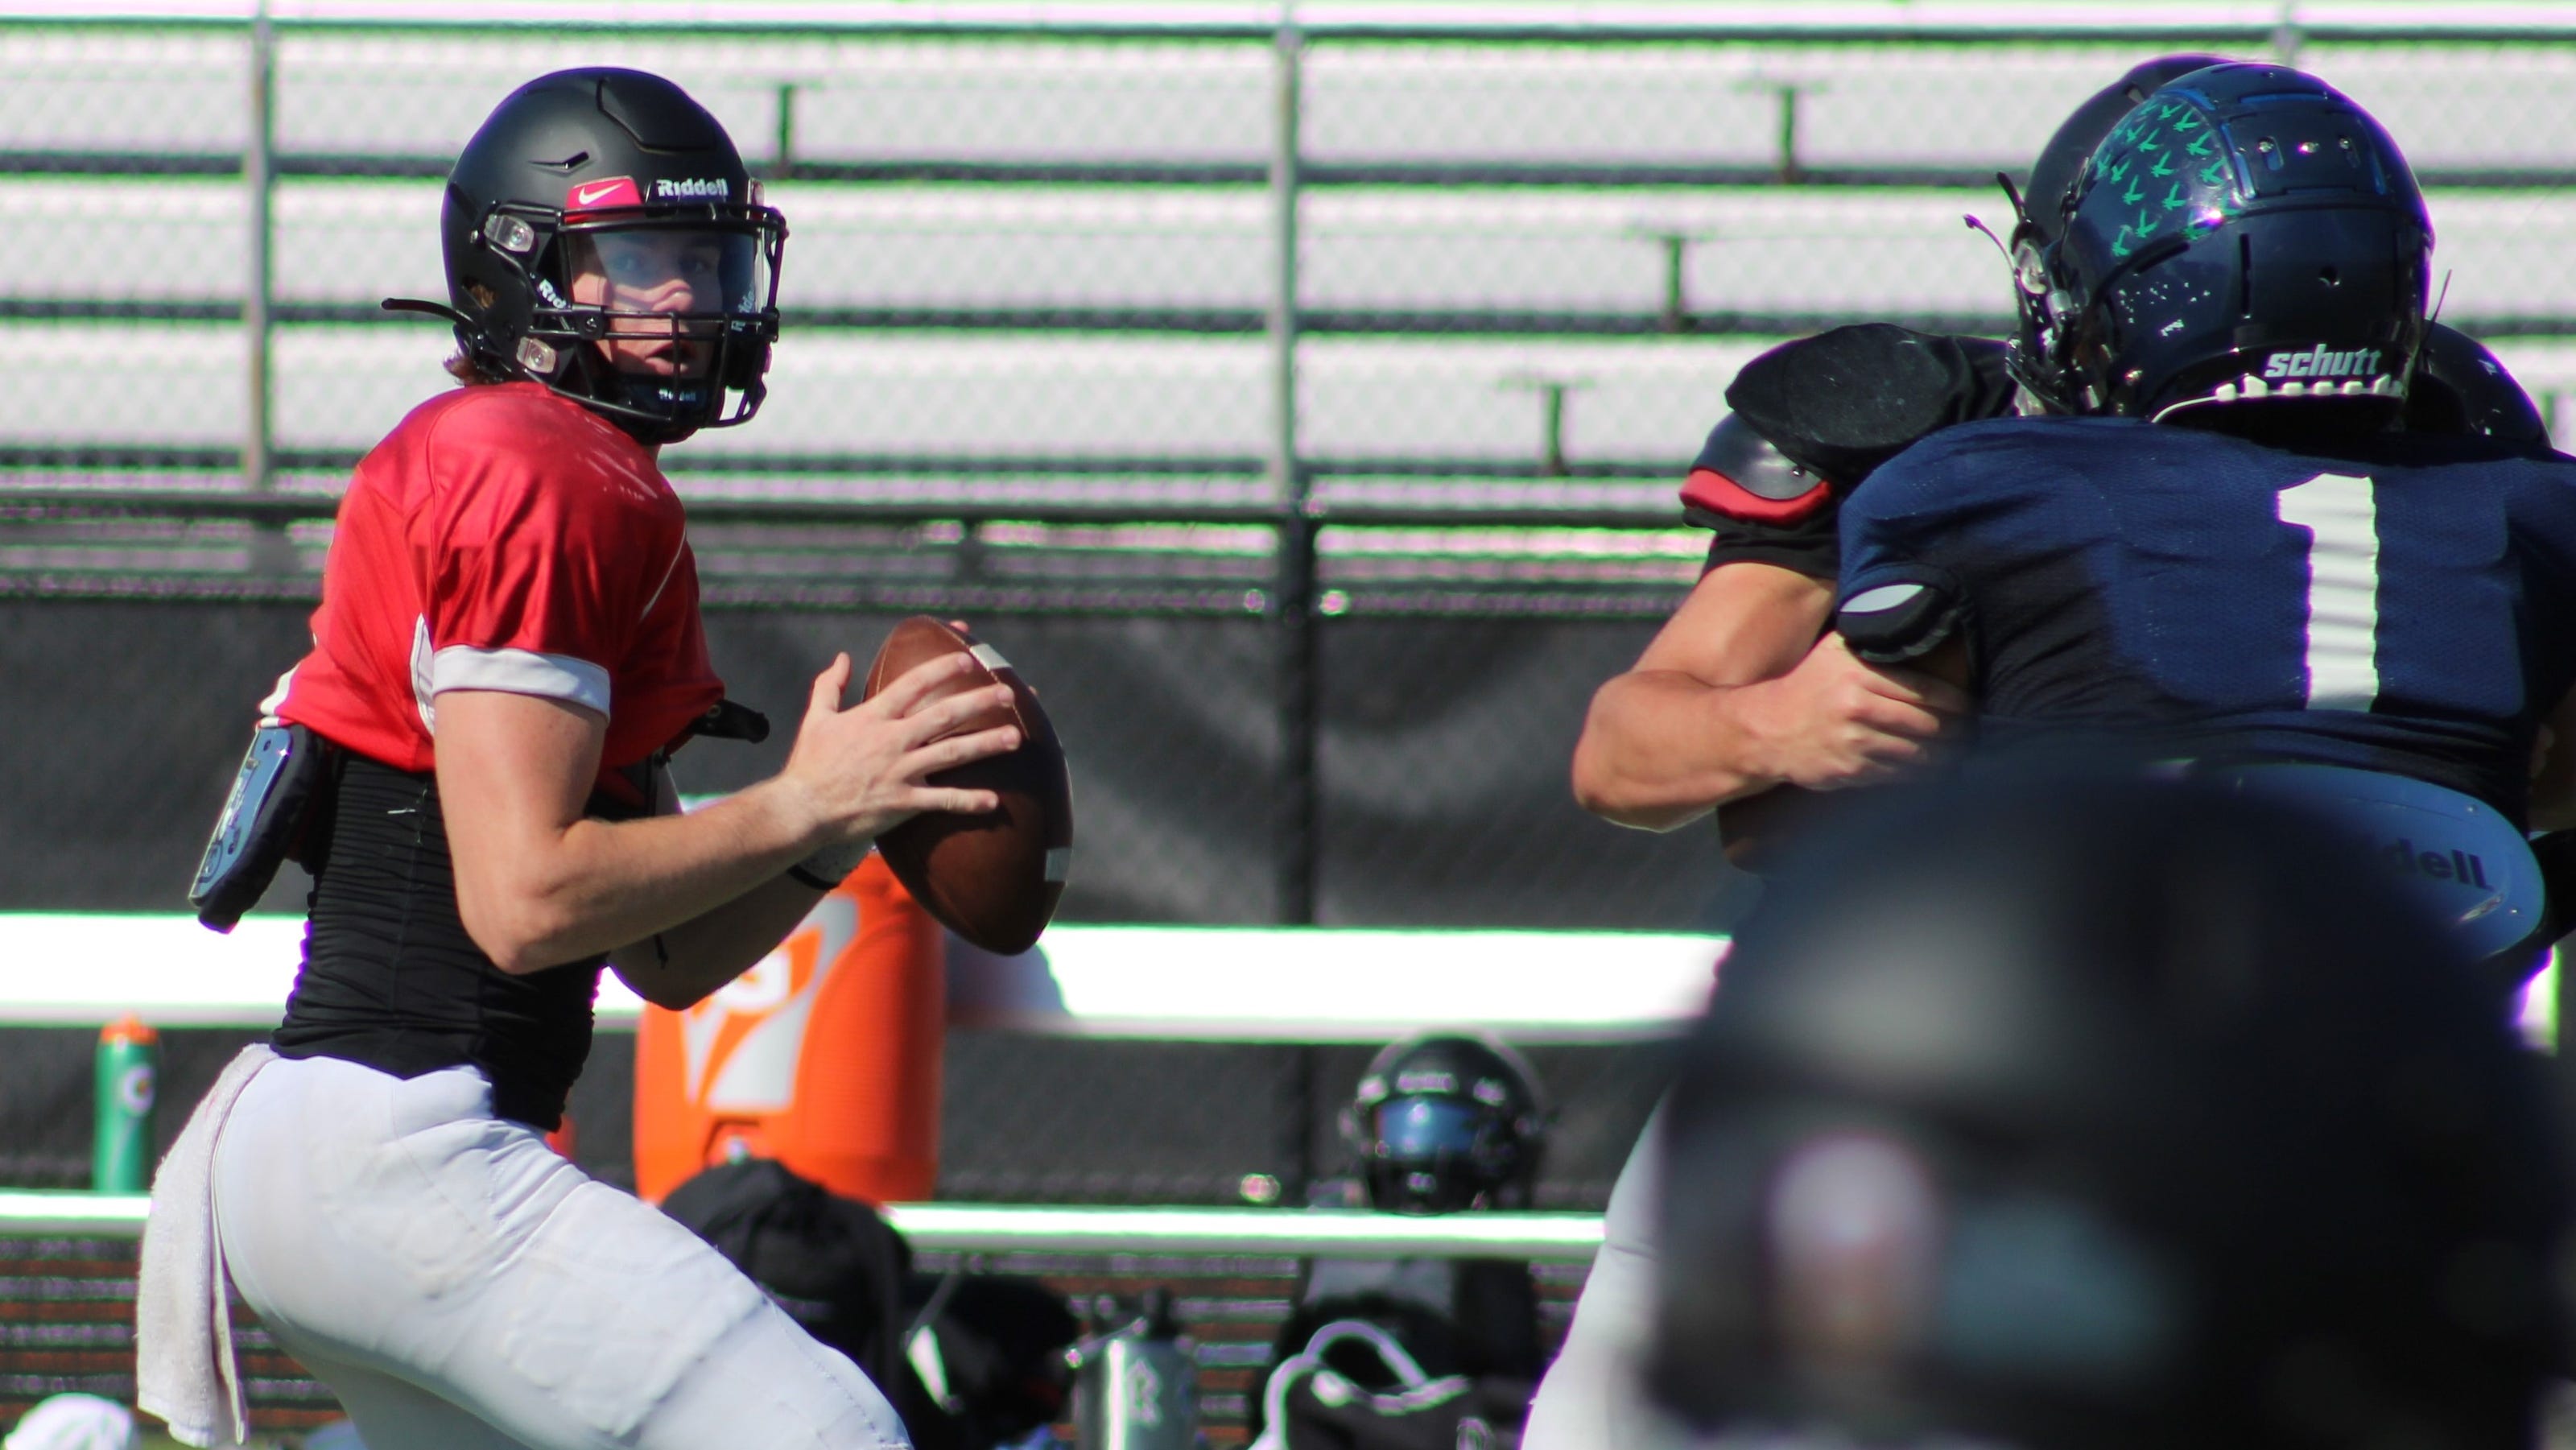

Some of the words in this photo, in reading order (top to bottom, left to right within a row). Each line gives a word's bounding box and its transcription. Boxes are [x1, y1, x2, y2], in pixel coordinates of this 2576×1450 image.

[656, 178, 728, 196] Riddell
[2264, 343, 2381, 377] schutt
[2275, 472, 2379, 709] 1
